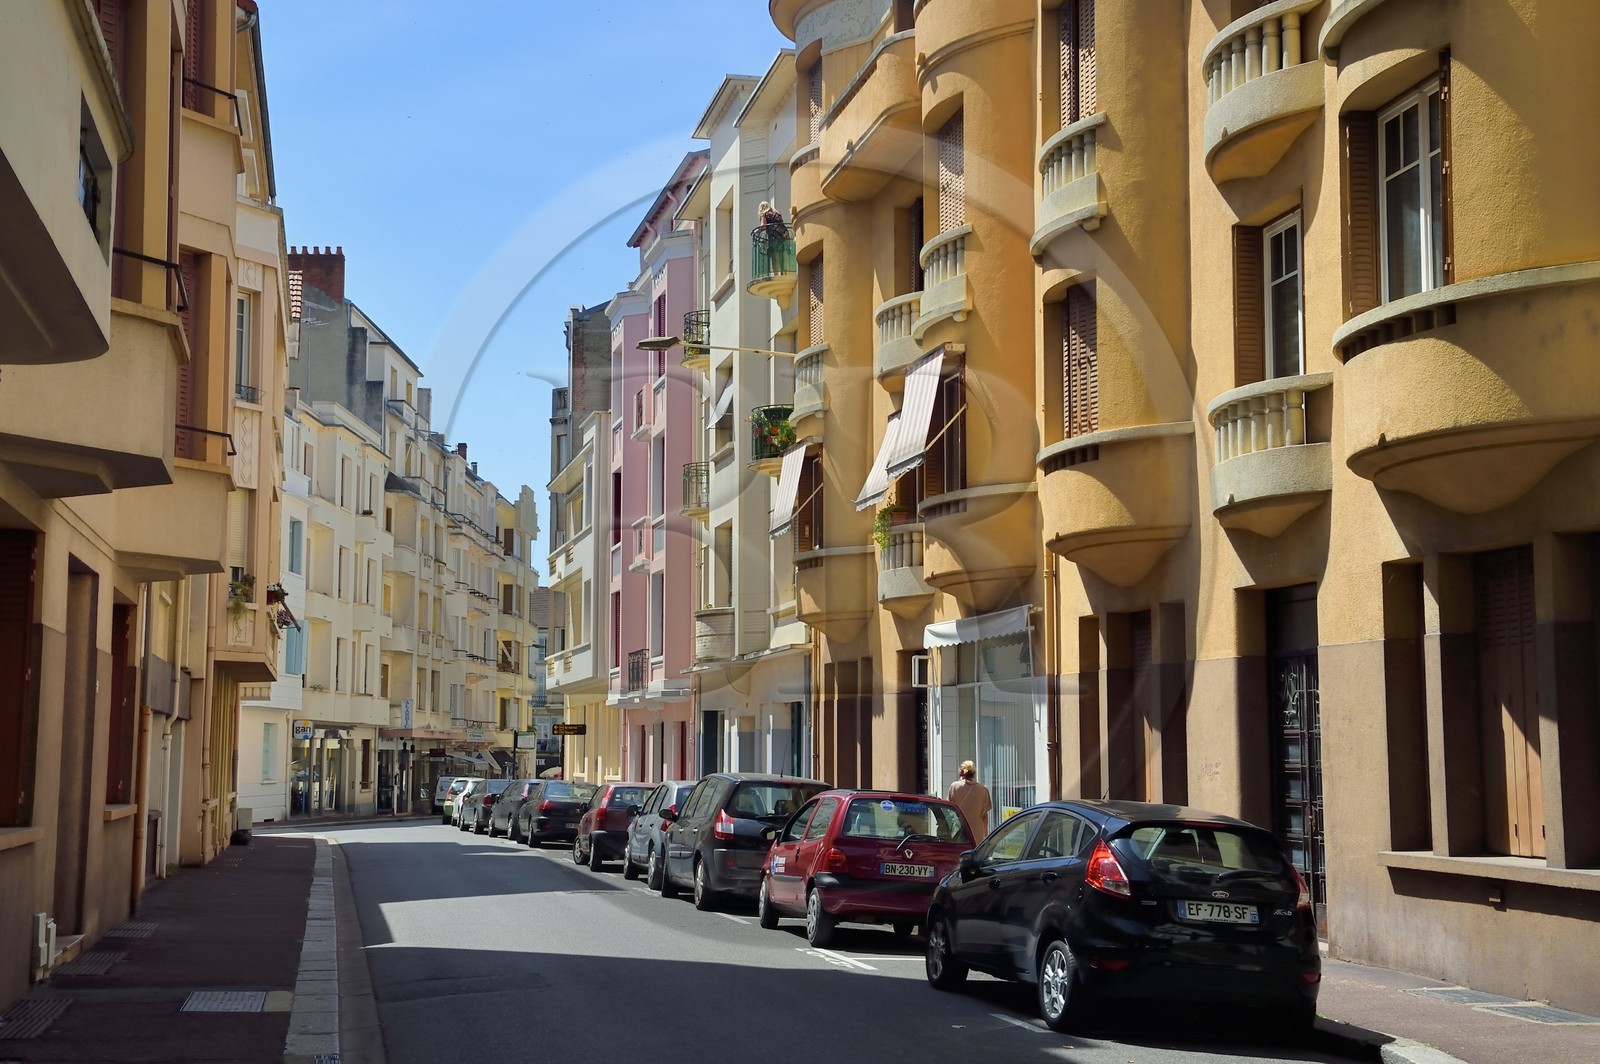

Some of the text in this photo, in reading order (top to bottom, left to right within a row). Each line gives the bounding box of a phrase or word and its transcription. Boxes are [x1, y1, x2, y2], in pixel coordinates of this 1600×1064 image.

[295, 725, 312, 735] gan
[885, 863, 929, 876] BN-230-VY
[1187, 902, 1248, 920] EF-778-SF
